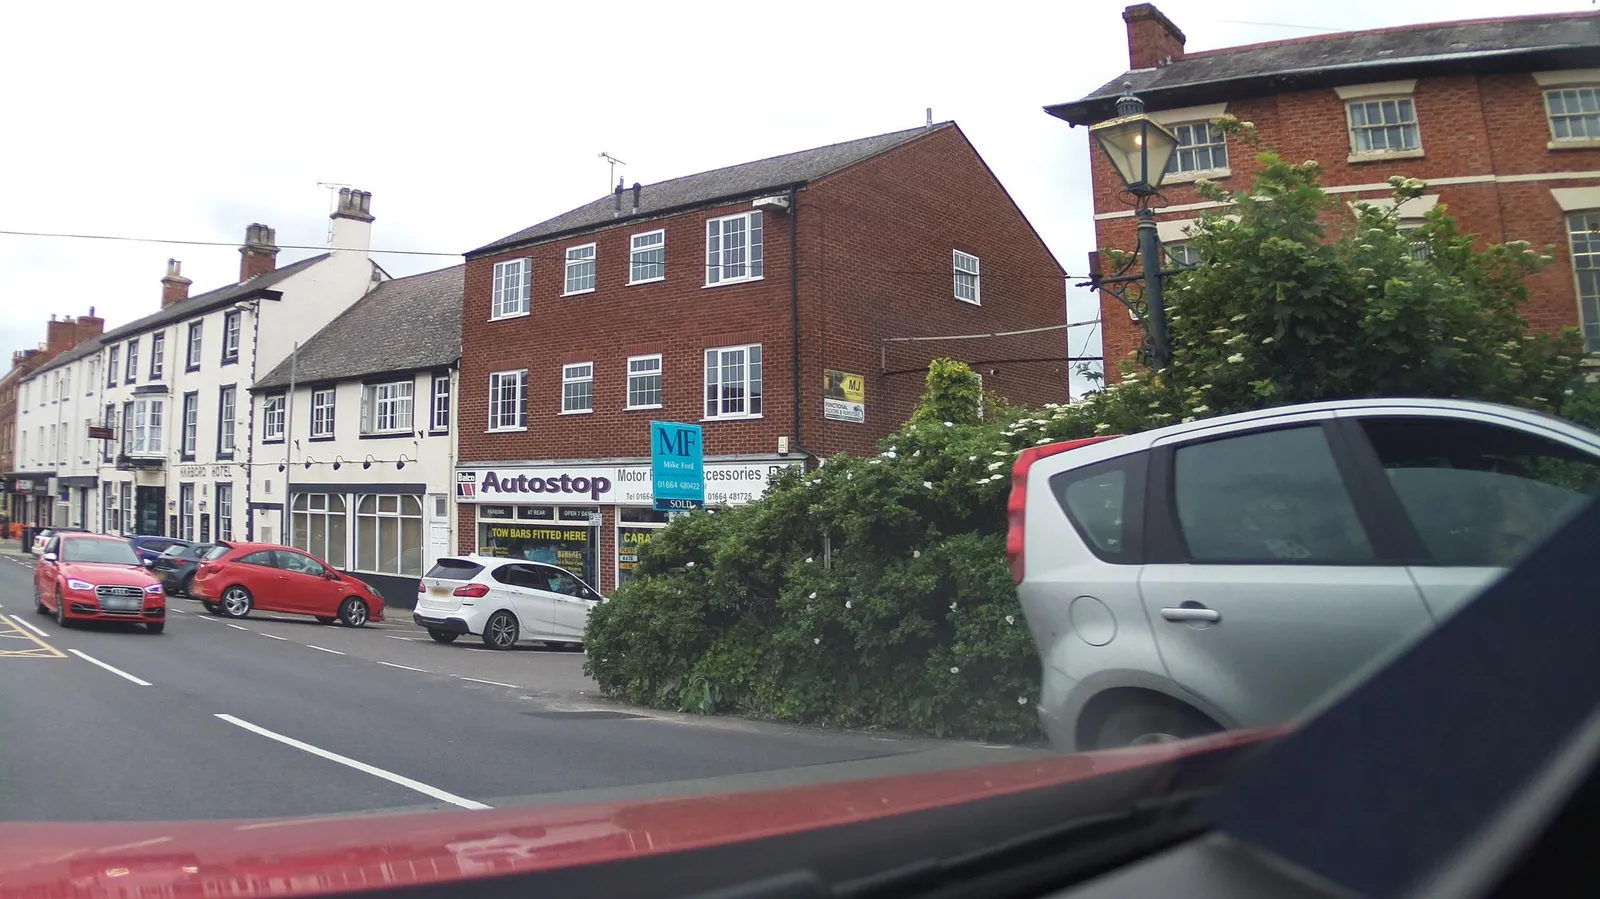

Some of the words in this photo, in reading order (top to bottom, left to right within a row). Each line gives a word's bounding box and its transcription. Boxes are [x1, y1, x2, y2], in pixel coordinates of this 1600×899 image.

[849, 380, 861, 391] MJ
[825, 402, 848, 410] FUNCTIONAL
[656, 427, 697, 457] MF
[663, 460, 679, 469] Mike
[680, 461, 695, 470] Ford
[180, 466, 207, 478] HARBORO
[211, 465, 233, 478] HOTEL
[617, 468, 647, 482] Motor
[481, 471, 612, 500] Autostop
[657, 480, 678, 489] 01664
[626, 492, 635, 501] Tel
[707, 492, 727, 501] 01664
[728, 491, 753, 501] 481725
[670, 499, 692, 509] SOLD
[492, 527, 509, 537] TOW
[510, 528, 531, 539] BARS
[533, 529, 561, 540] FITTED
[563, 530, 587, 542] HERE
